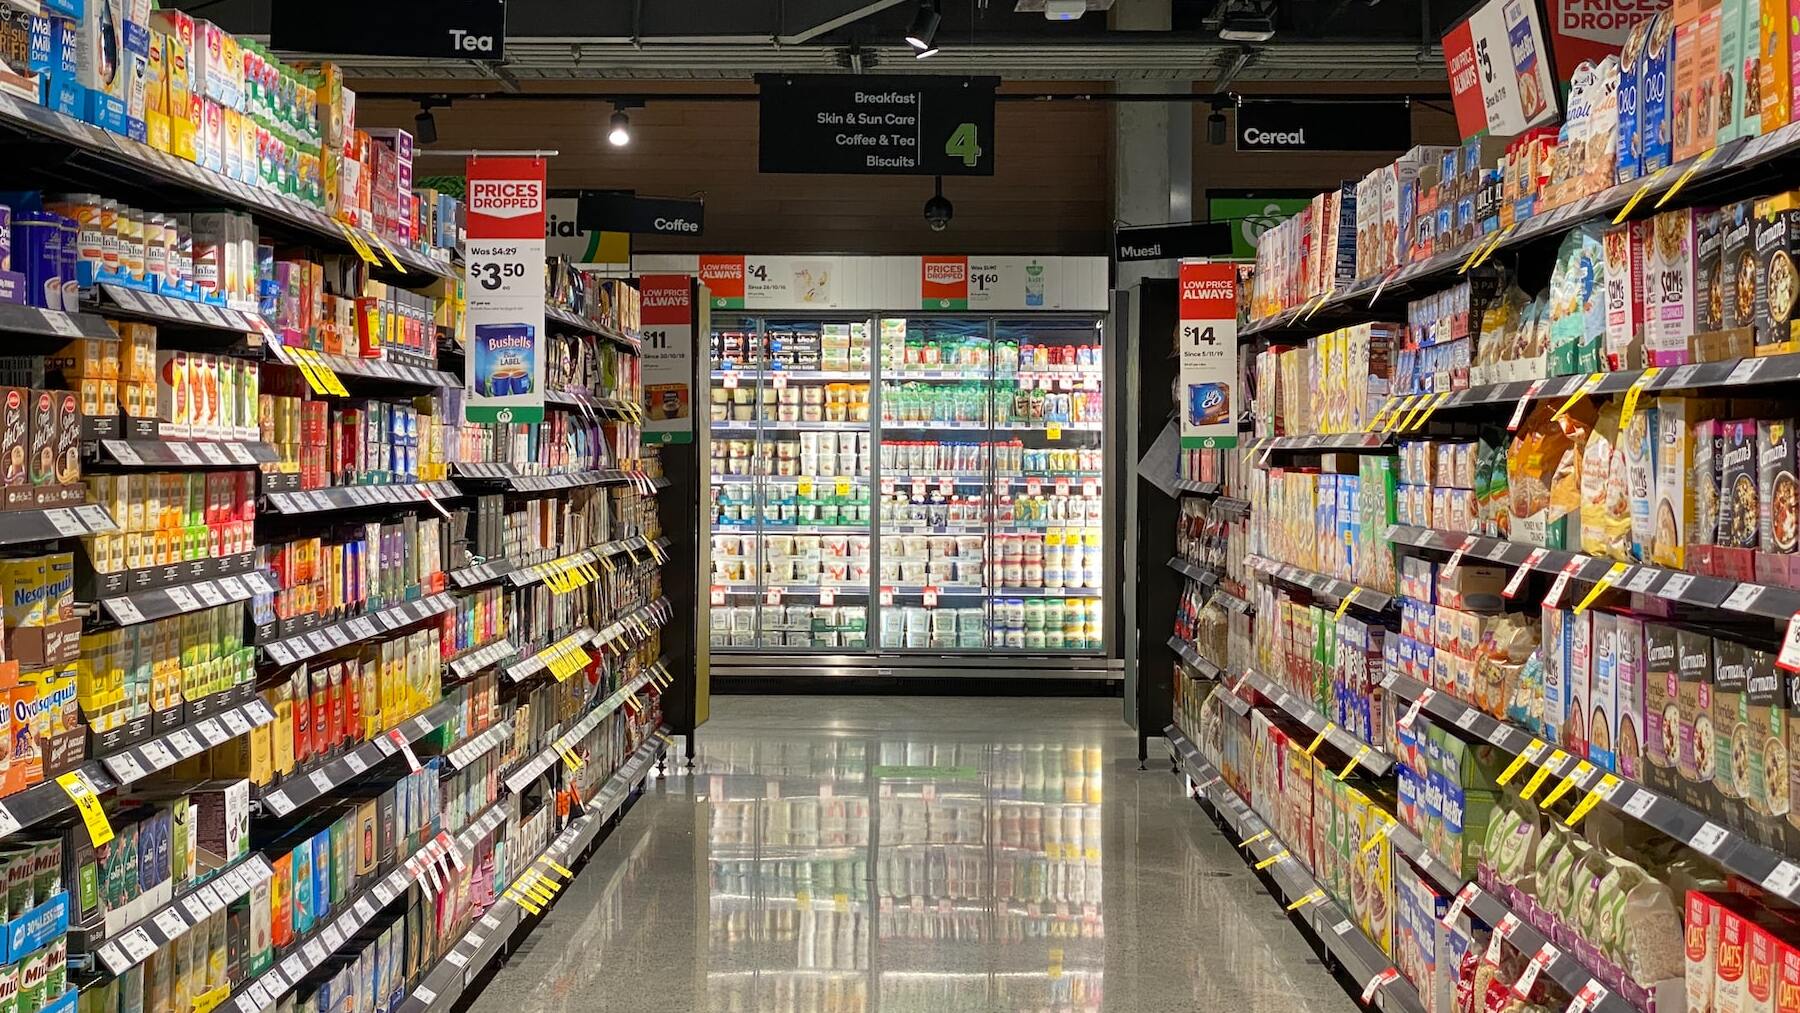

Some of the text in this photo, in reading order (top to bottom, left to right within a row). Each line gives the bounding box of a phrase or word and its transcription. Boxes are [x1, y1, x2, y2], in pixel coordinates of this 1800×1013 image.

[449, 30, 493, 52] Tea
[855, 92, 915, 104] Breakfast
[817, 112, 915, 125] Skin & Sun Care
[836, 134, 915, 146] Coffee & Tea
[1244, 128, 1305, 144] Cereal
[946, 123, 982, 166] 4
[866, 156, 915, 167] Biscuits
[474, 184, 538, 197] PRICES
[474, 199, 538, 208] DROPPED
[654, 218, 698, 232] Coffee
[1121, 244, 1161, 257] Muesli
[748, 264, 767, 281] $4
[1183, 289, 1234, 300] ALWAYS
[642, 297, 688, 306] ALWAYS
[644, 331, 666, 348] $11
[1184, 326, 1216, 345] $14
[489, 335, 531, 351] Bushells
